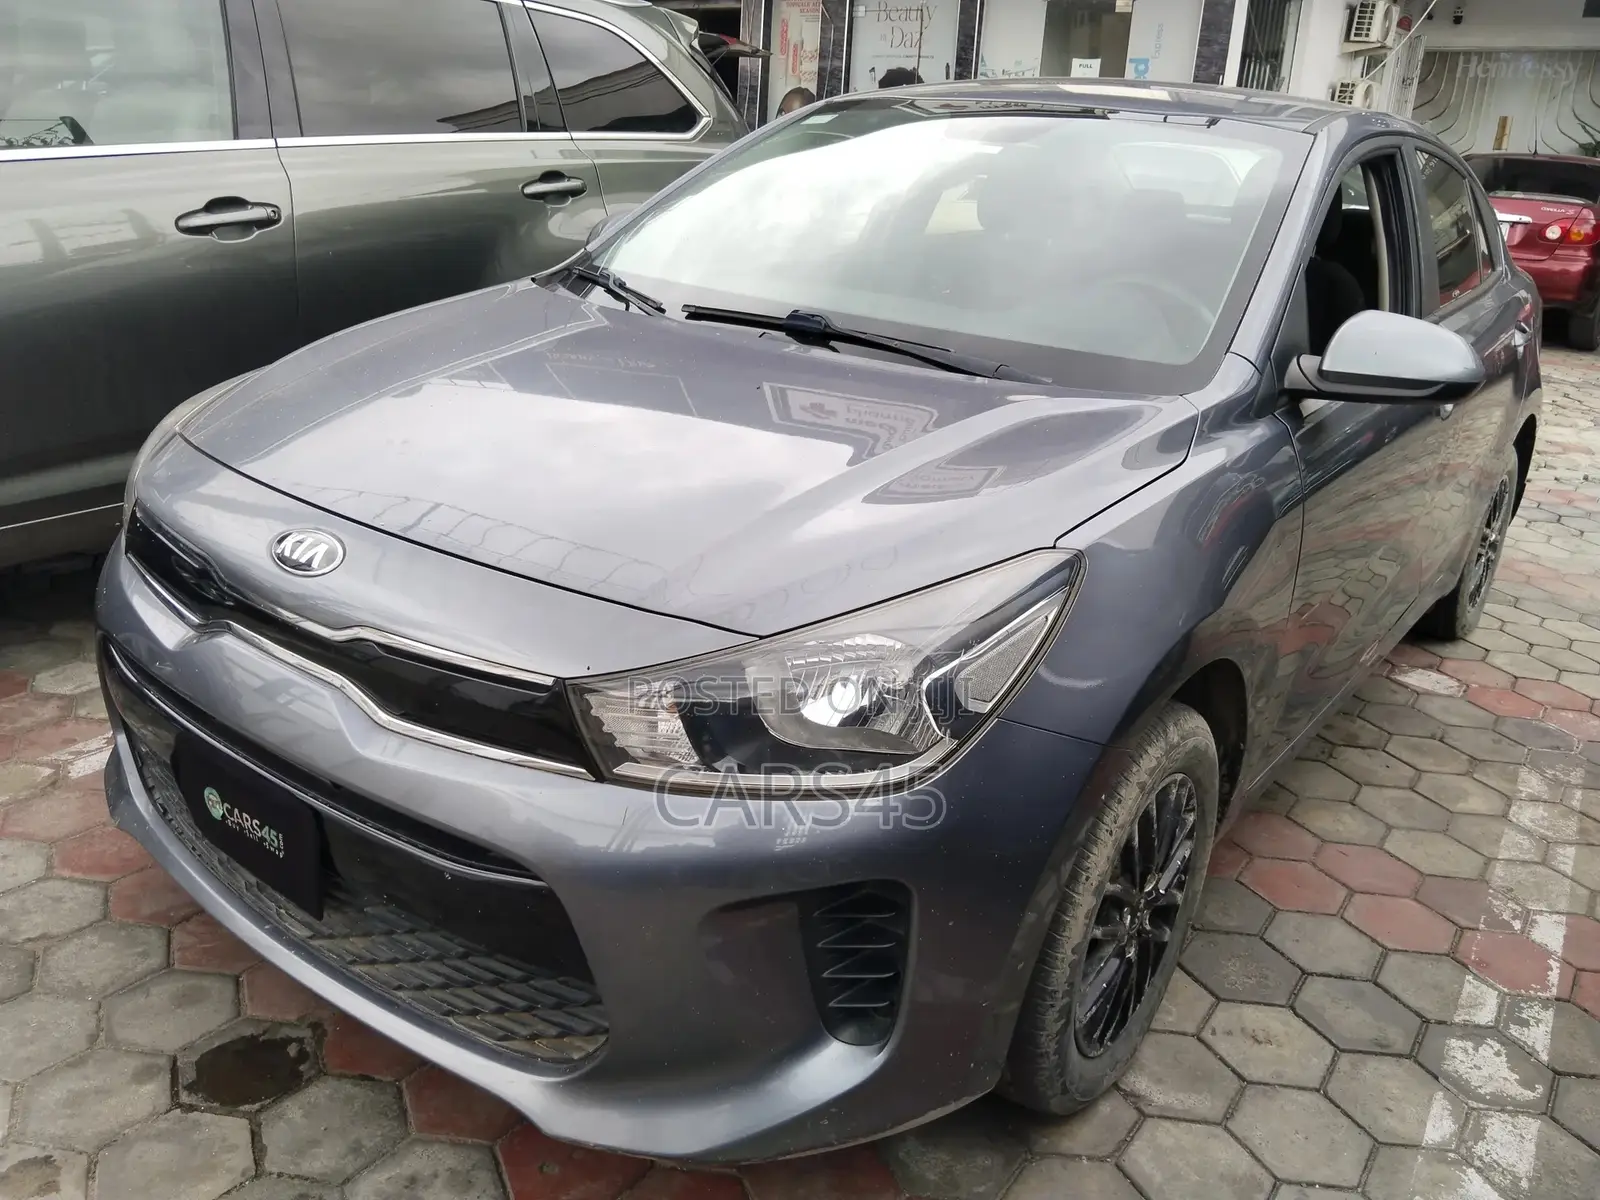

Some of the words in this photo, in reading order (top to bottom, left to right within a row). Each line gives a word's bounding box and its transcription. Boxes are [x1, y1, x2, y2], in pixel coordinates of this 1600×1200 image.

[877, 0, 938, 30] Beauty
[276, 532, 329, 569] KIA
[223, 802, 279, 849] CARS45
